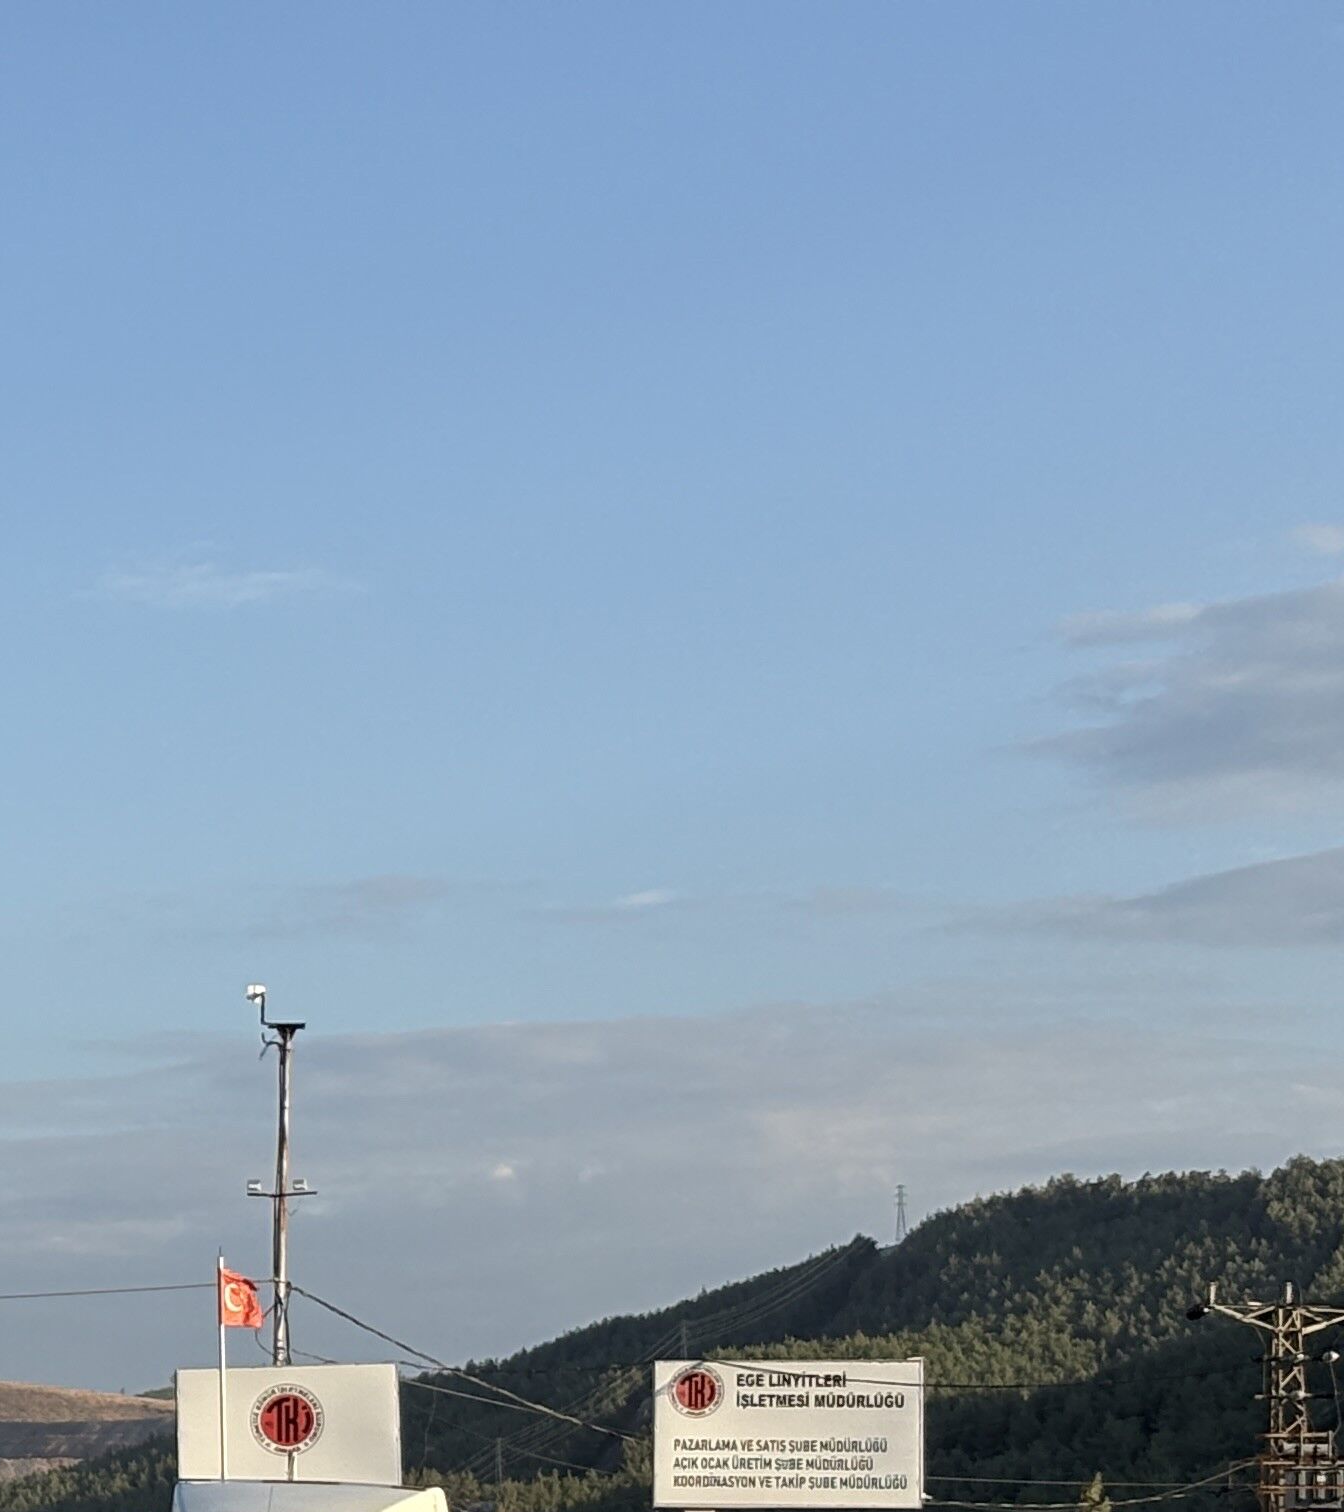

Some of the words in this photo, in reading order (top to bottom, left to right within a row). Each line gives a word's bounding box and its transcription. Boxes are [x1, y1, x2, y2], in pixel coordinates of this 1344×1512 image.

[736, 1373, 765, 1388] EGE
[736, 1391, 810, 1409] İŞLETMESİ
[814, 1391, 905, 1409] MÜDÜRLÜĞÜ
[673, 1438, 738, 1452] PAZARLAMA
[739, 1439, 754, 1452] VE
[820, 1437, 888, 1453] MÜDÜRLÜĞÜ
[673, 1457, 699, 1471] AÇIK
[700, 1457, 730, 1470] OCAK
[731, 1455, 772, 1470] ÜRETİM
[805, 1455, 874, 1471] MÜDÜRLÜĞÜ
[758, 1475, 773, 1488] VE
[774, 1473, 807, 1489] TAKİP
[808, 1475, 838, 1490] ŞUBE
[839, 1473, 908, 1490] MÜDÜRLÜĞÜ
